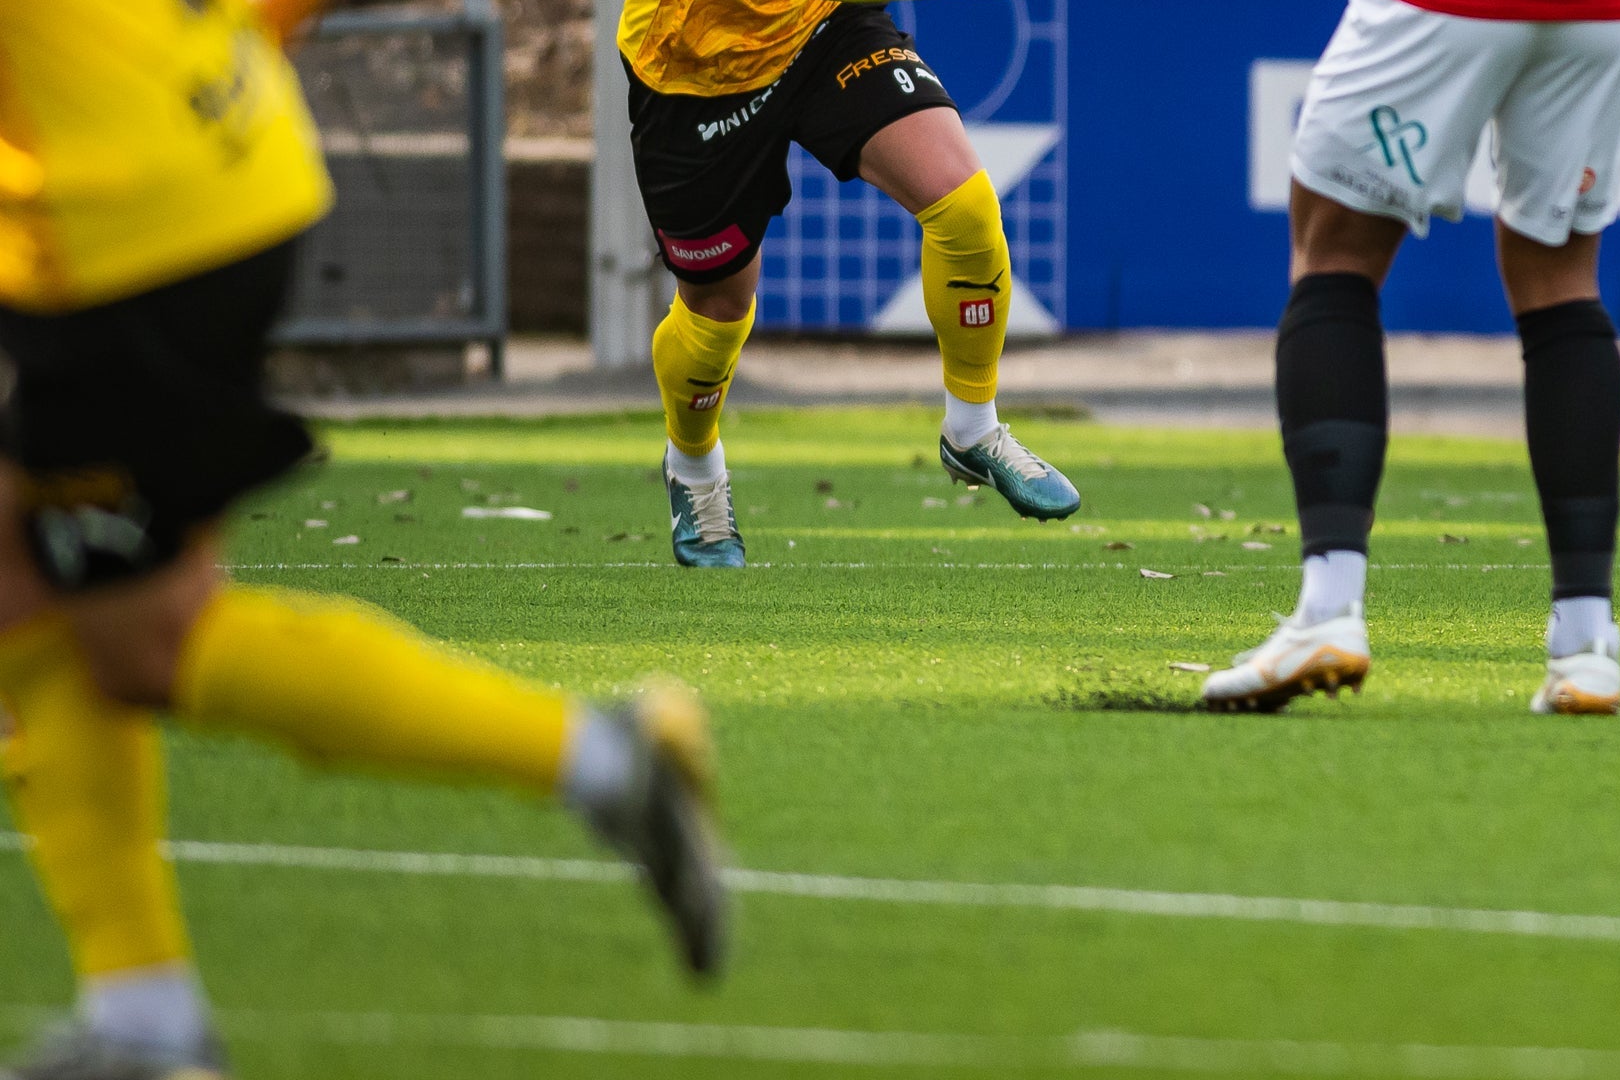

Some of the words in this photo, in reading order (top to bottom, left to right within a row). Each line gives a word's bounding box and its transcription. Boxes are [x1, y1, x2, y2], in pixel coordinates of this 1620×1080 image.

[836, 47, 924, 90] FRESS
[893, 67, 915, 94] 9
[671, 240, 733, 262] SAVONIA
